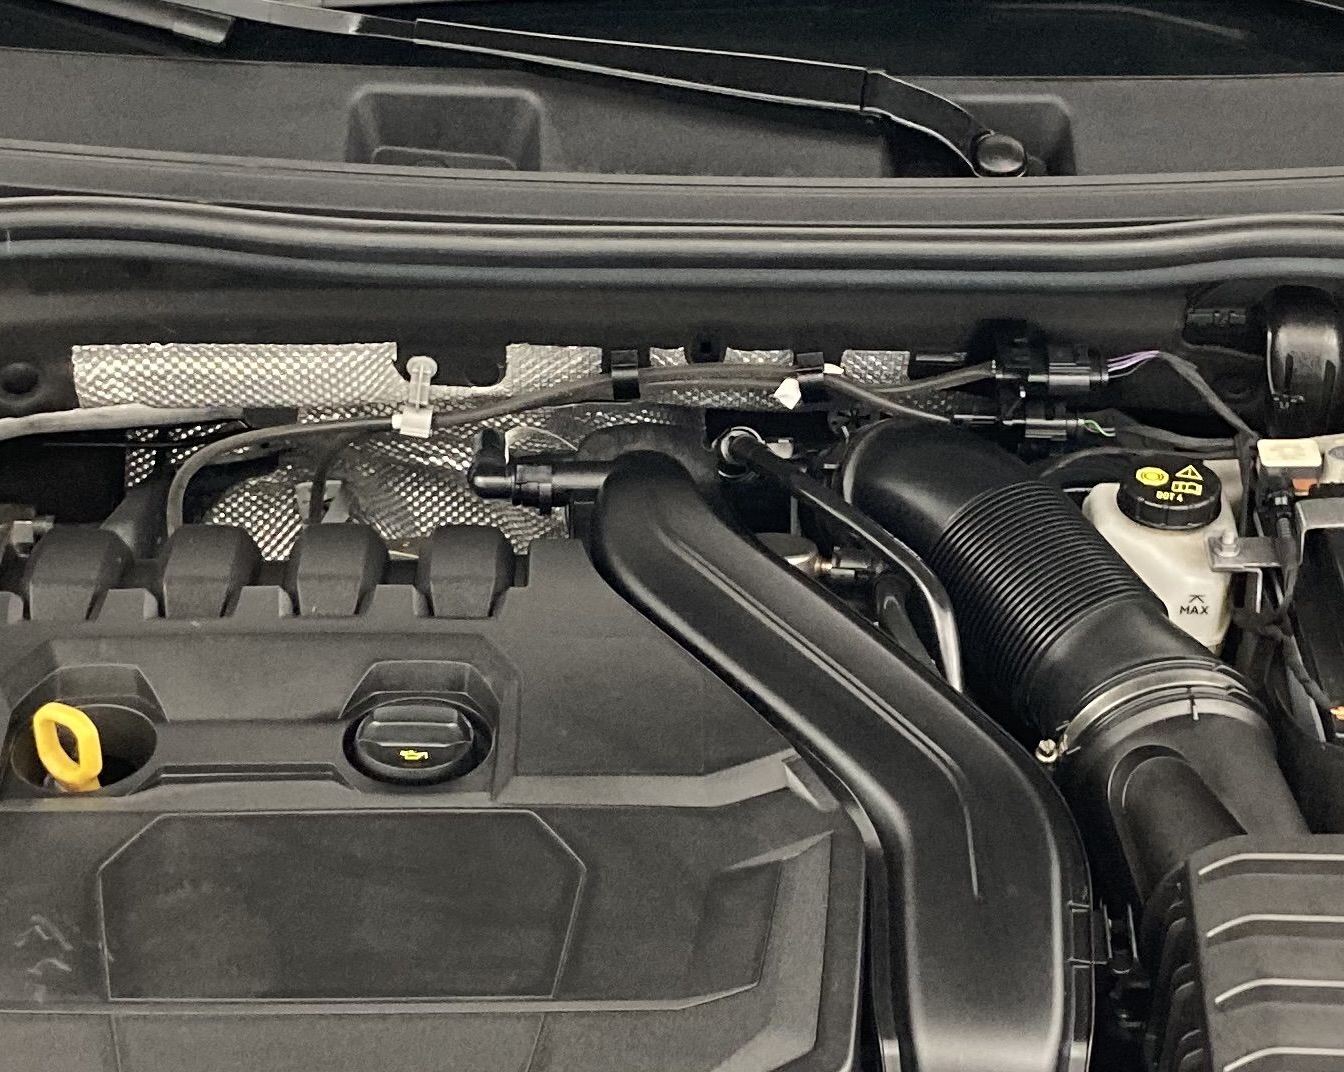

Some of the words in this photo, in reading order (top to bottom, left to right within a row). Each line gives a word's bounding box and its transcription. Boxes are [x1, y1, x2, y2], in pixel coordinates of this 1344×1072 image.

[1156, 490, 1175, 501] DOT
[1176, 493, 1184, 503] 4
[1179, 605, 1209, 615] MAX
